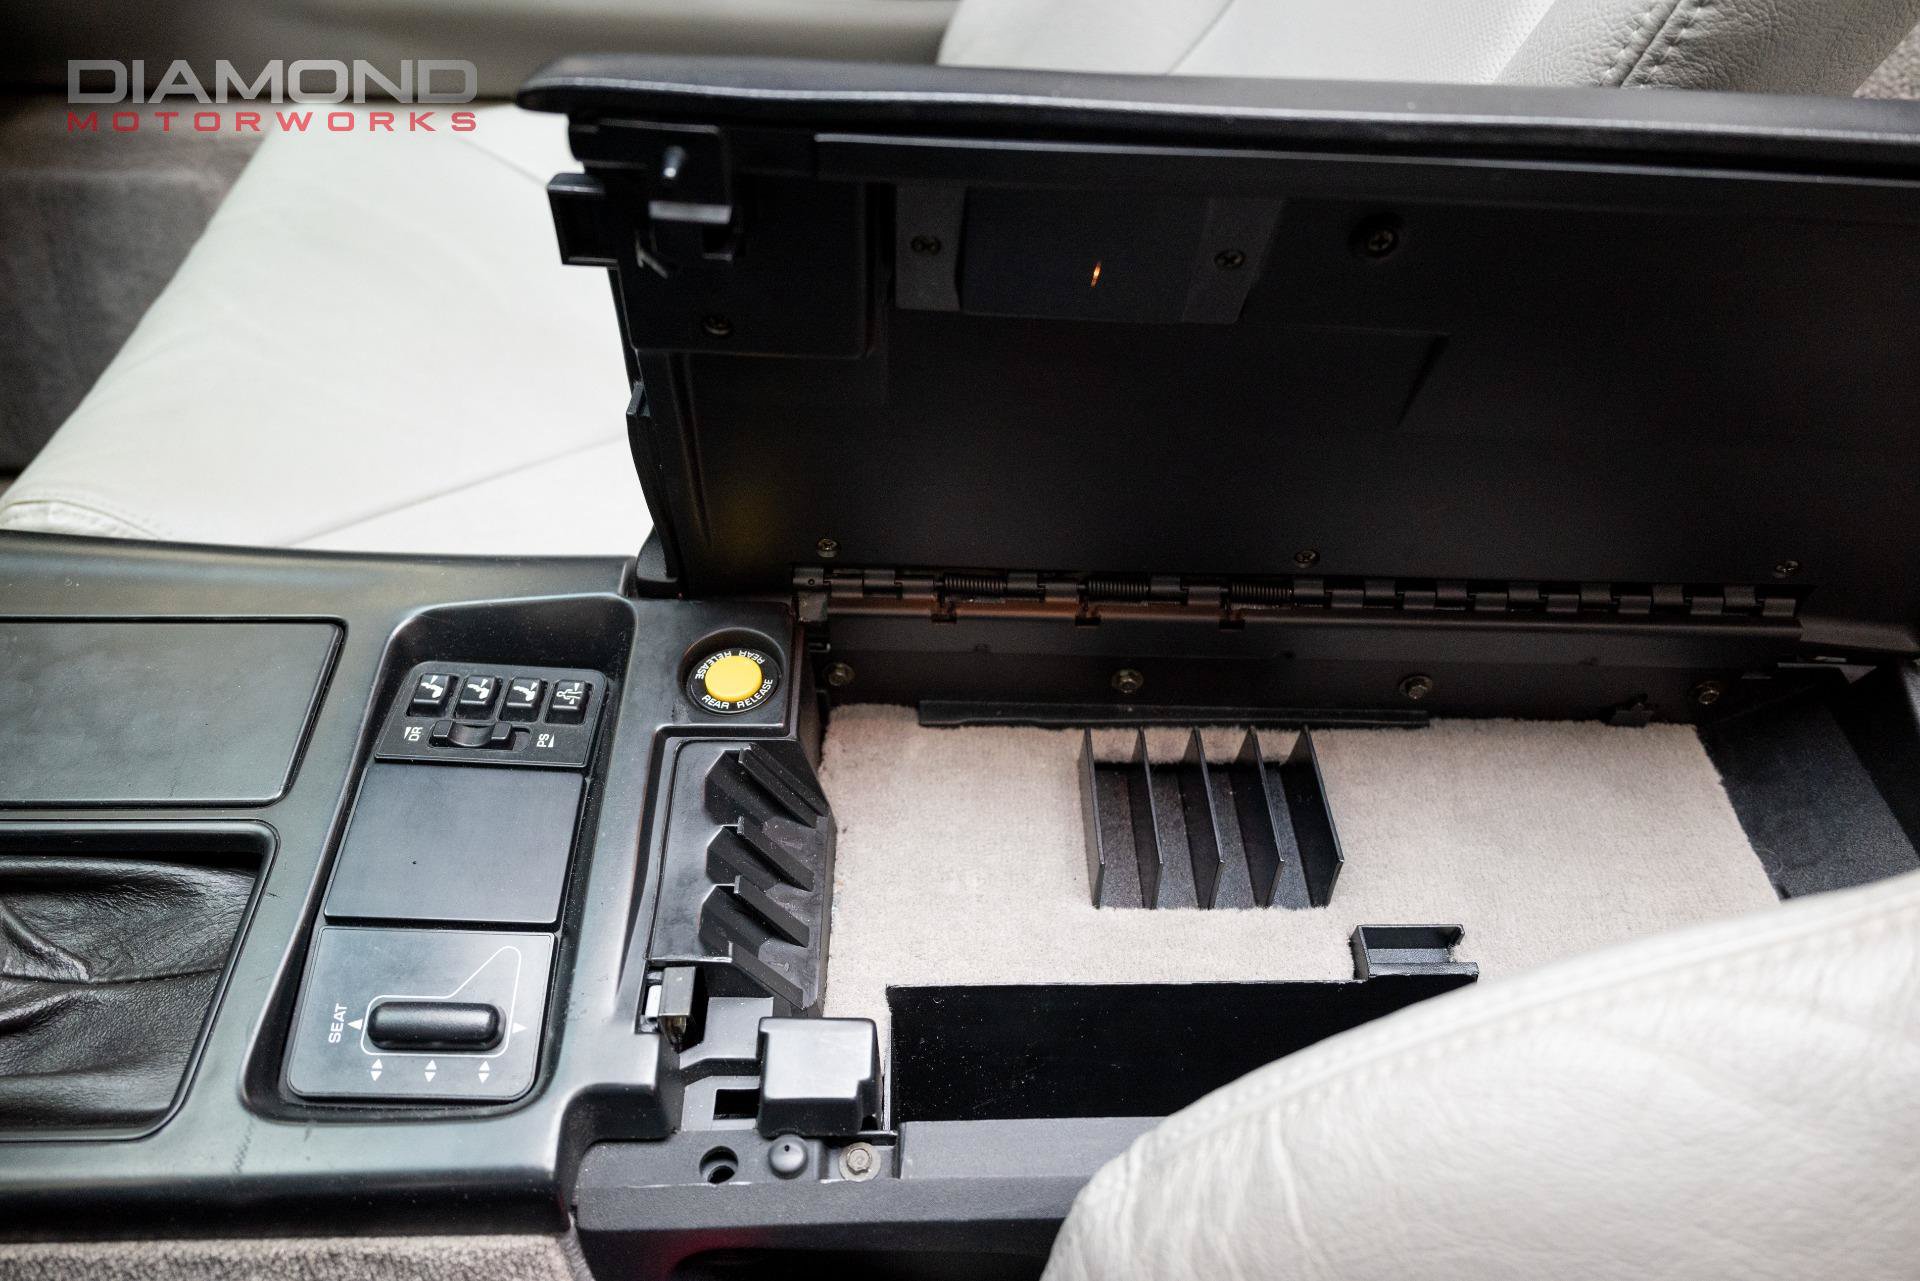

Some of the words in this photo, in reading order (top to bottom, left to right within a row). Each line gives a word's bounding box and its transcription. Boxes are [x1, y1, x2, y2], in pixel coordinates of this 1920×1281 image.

[695, 650, 732, 680] RELEASE
[738, 650, 766, 664] REAR
[701, 694, 730, 710] REAR
[736, 679, 773, 709] RELEASE
[408, 726, 424, 742] DR
[537, 733, 550, 748] PS
[328, 1003, 348, 1043] SEAT
